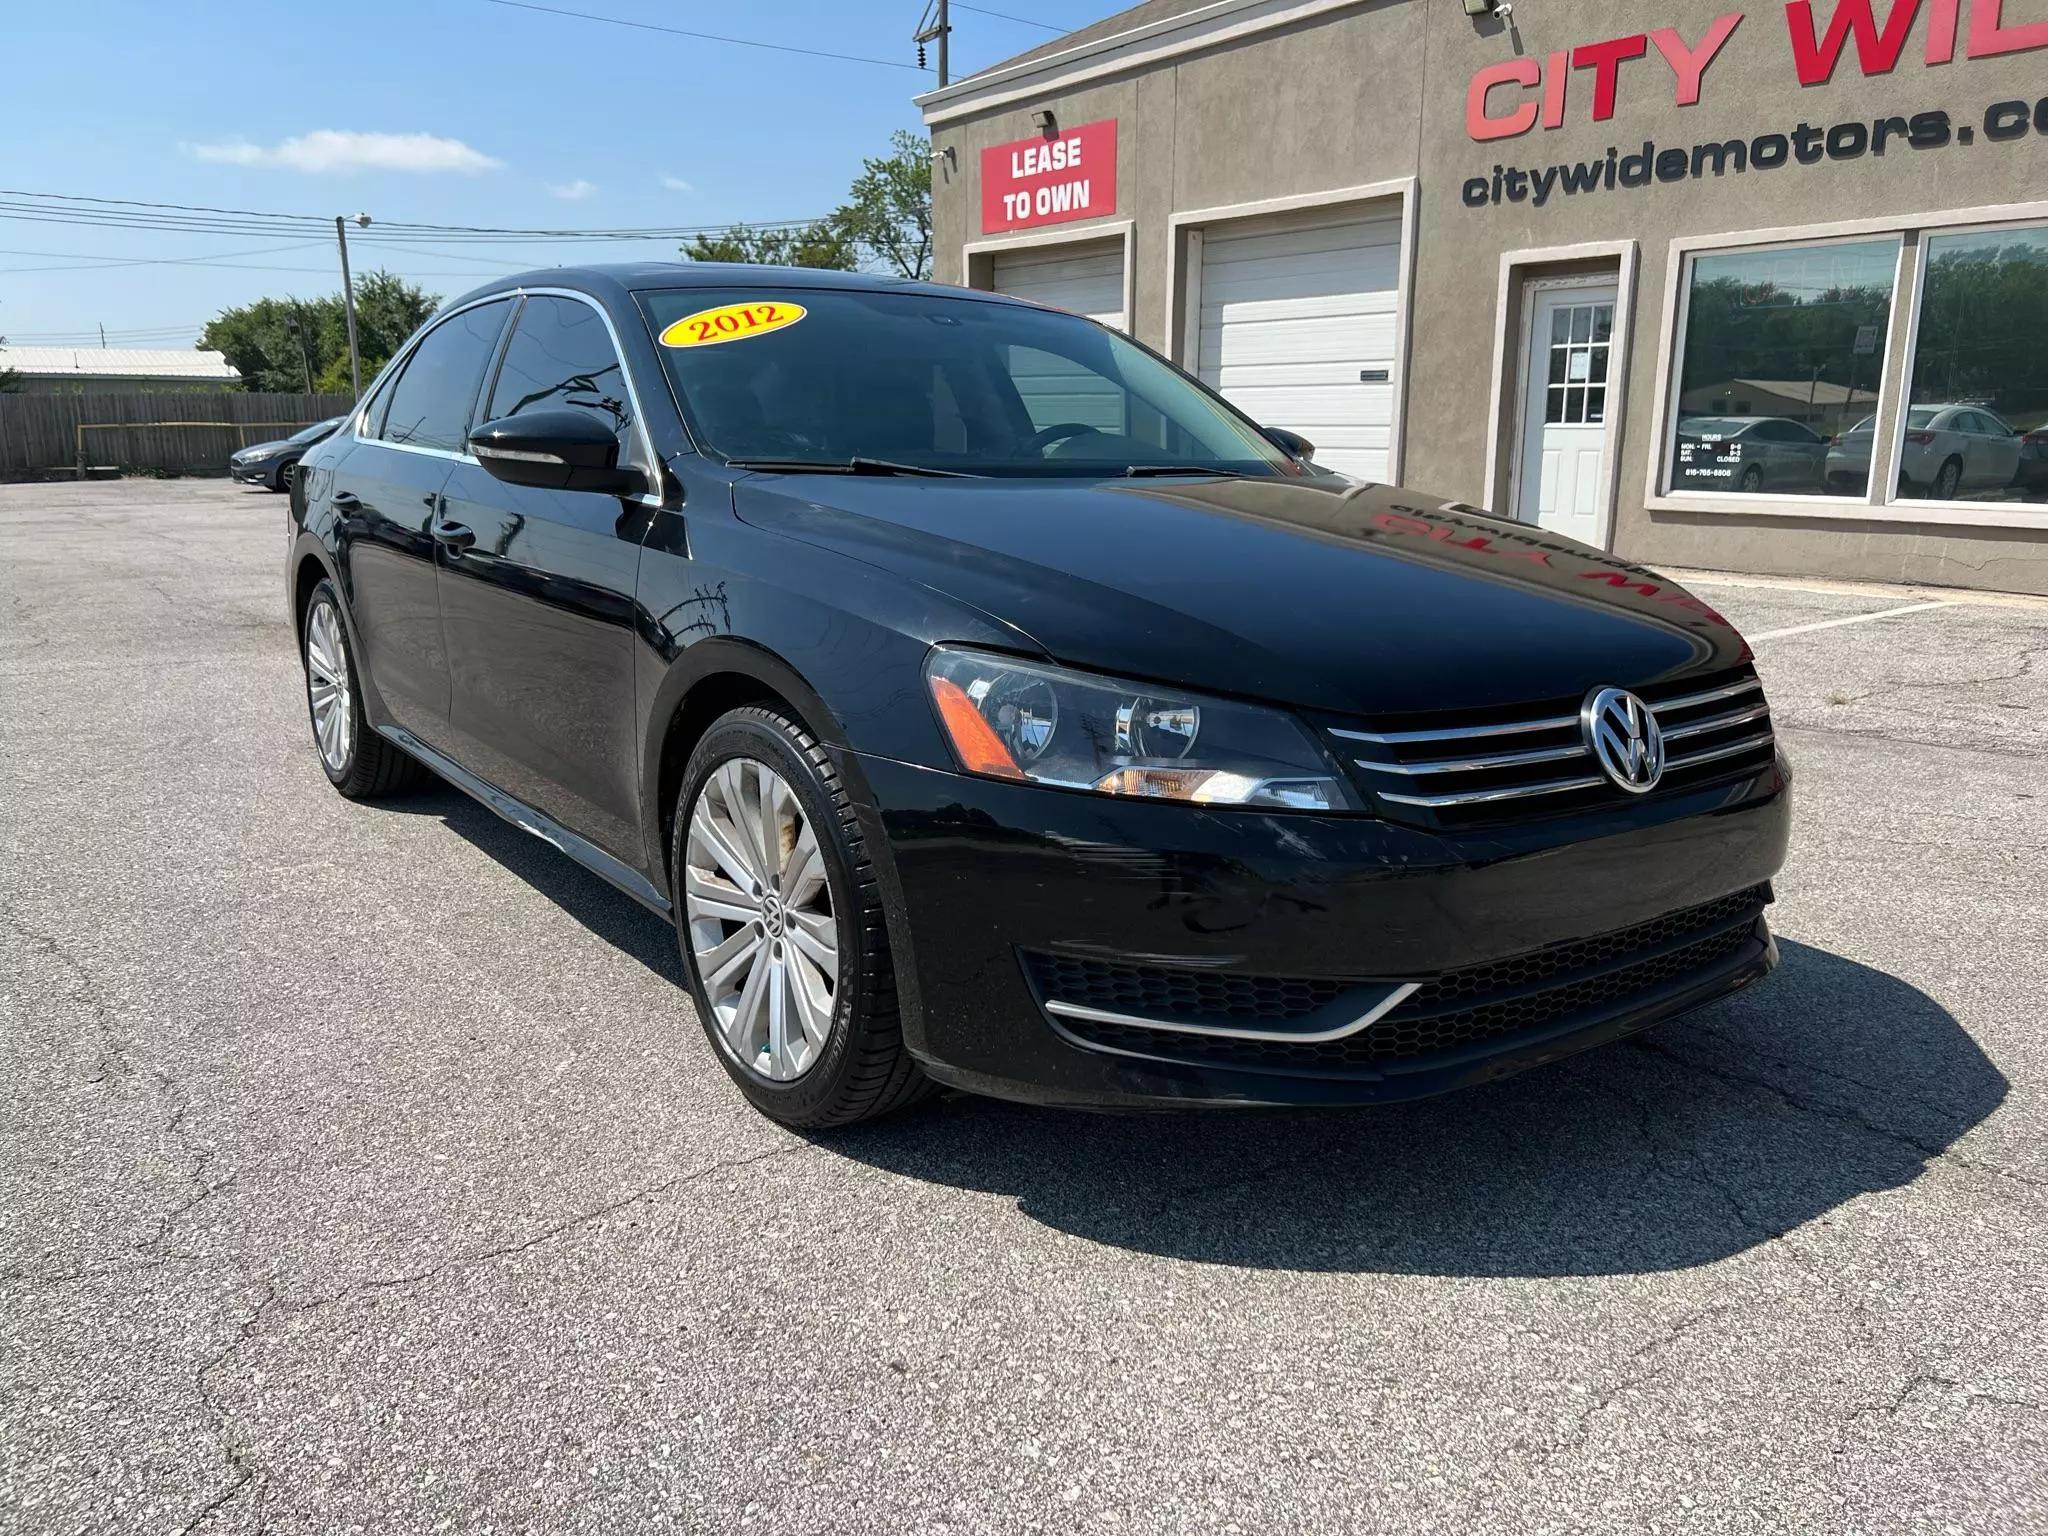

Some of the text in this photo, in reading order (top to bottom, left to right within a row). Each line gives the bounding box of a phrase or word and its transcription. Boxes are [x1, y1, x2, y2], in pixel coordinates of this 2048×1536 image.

[1466, 13, 1745, 141] CITY
[1012, 137, 1081, 179] LEASE
[1003, 179, 1089, 221] TO OWN
[689, 305, 784, 341] 2012
